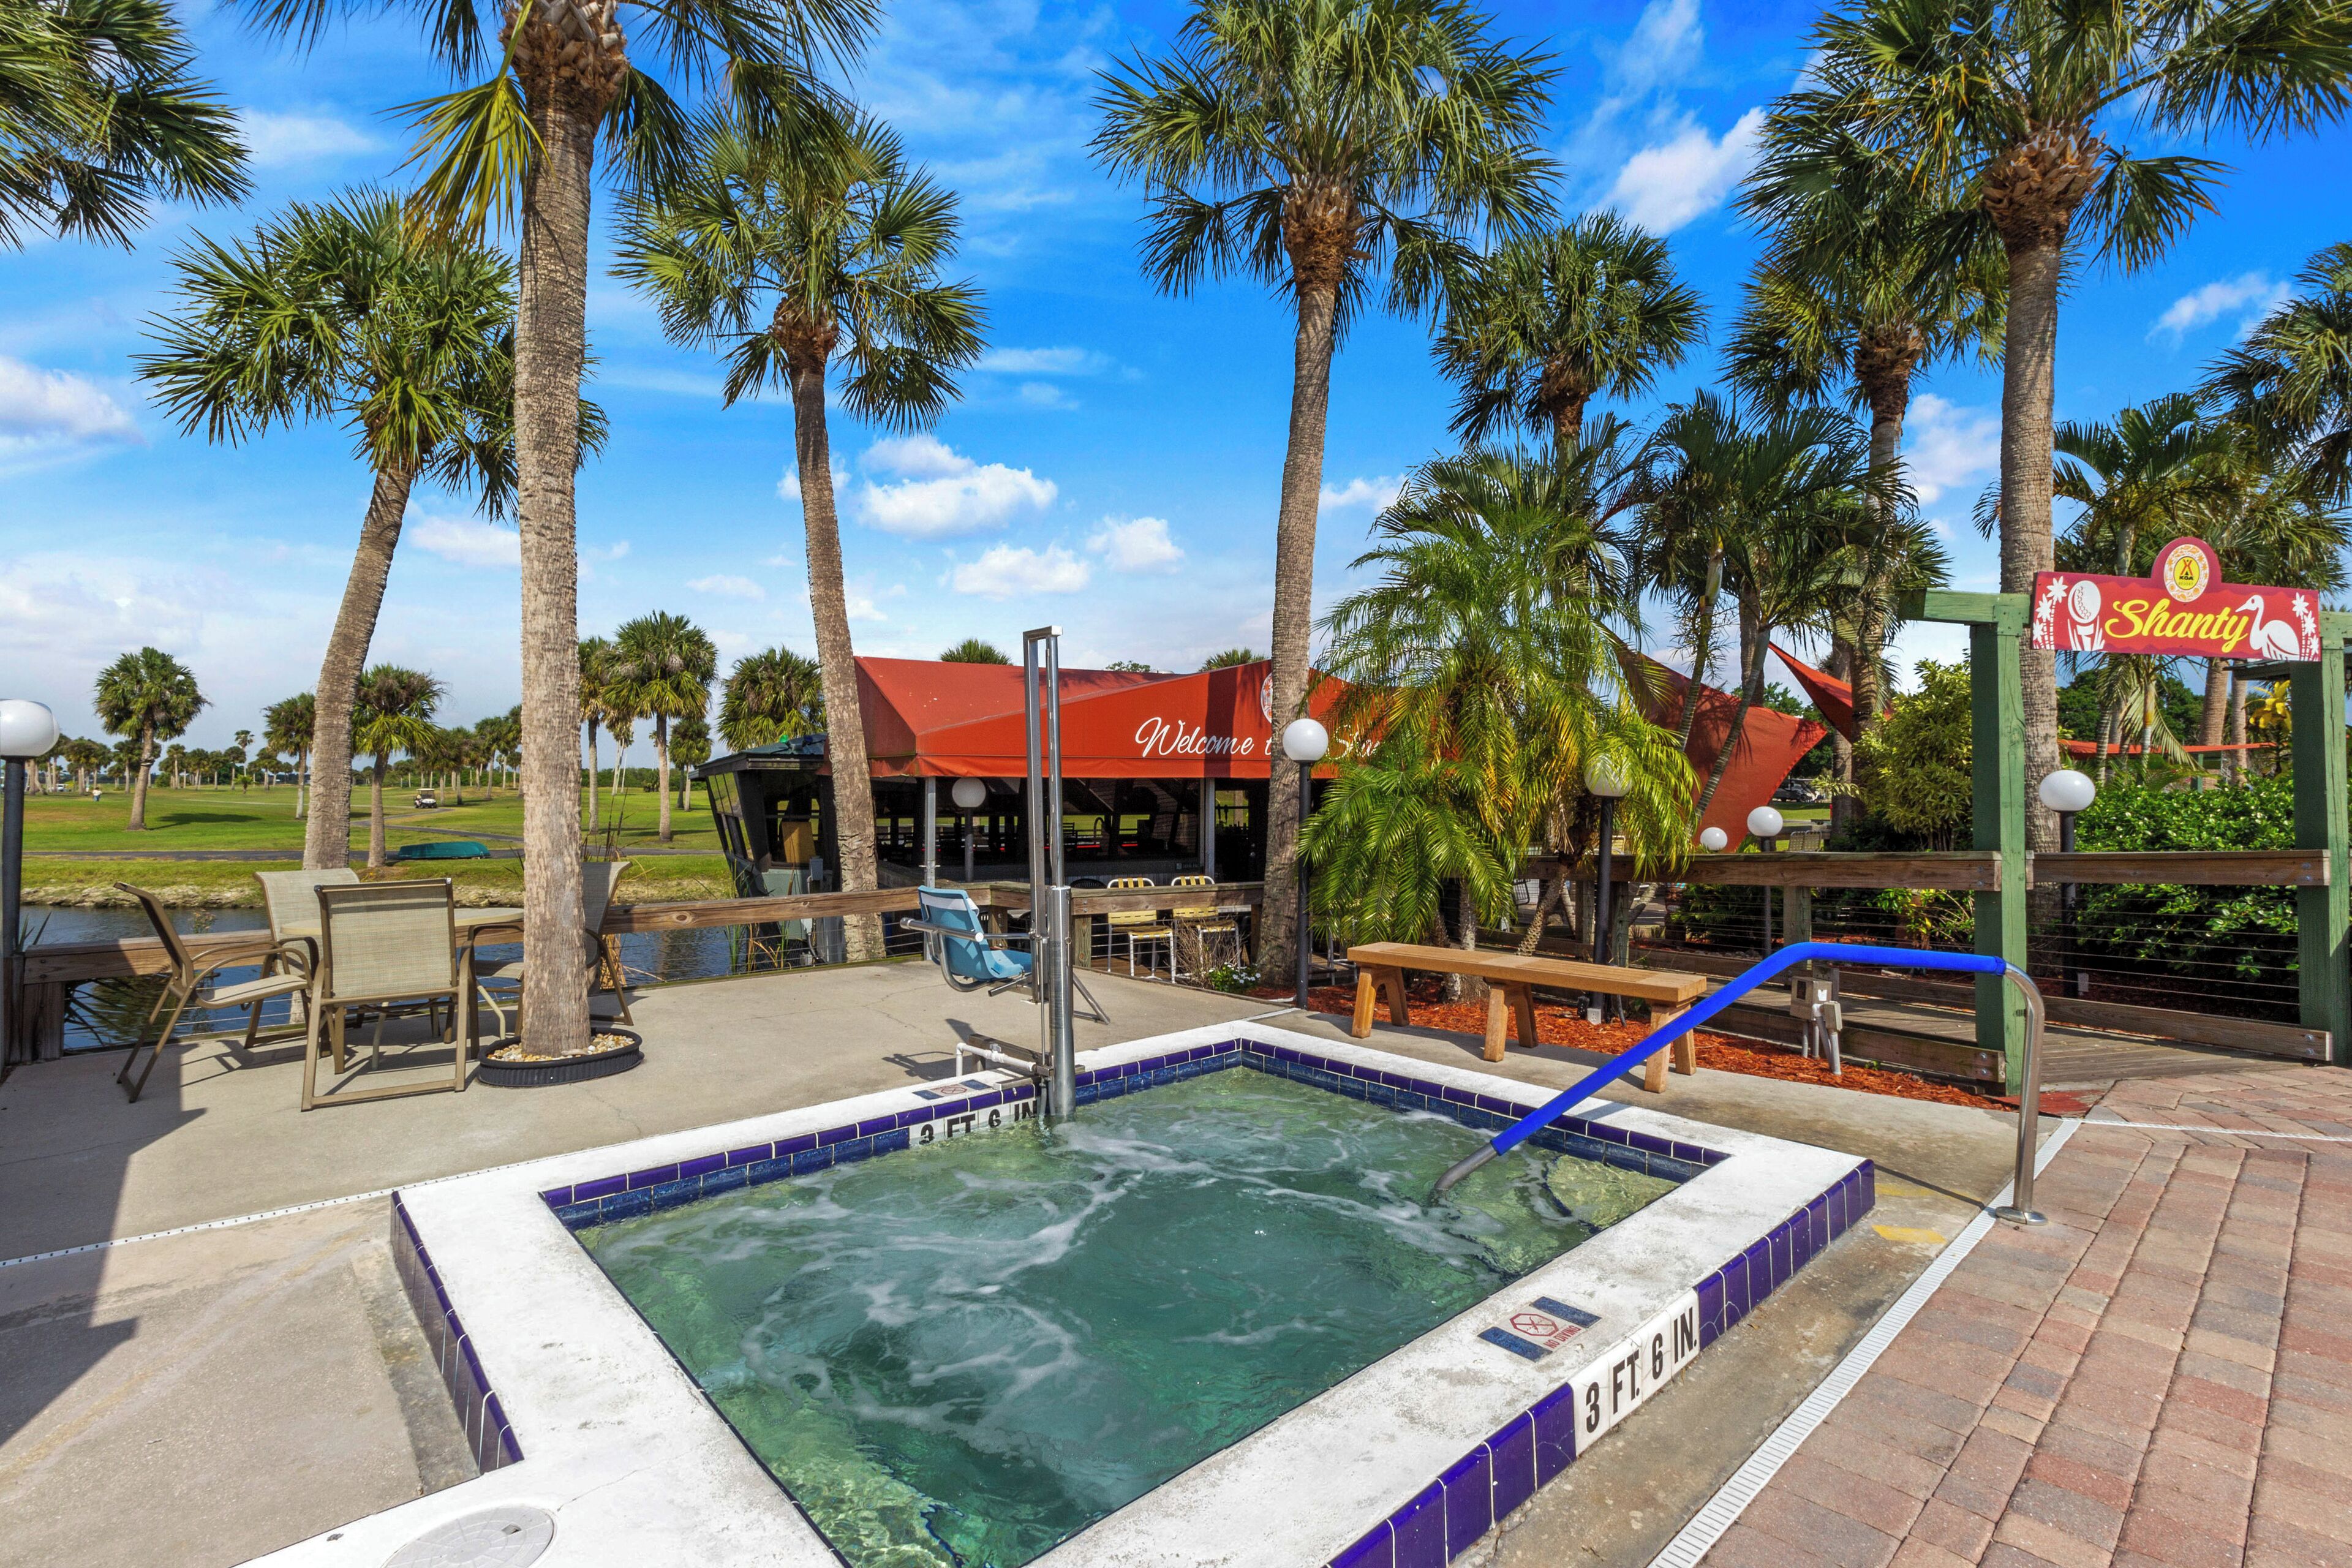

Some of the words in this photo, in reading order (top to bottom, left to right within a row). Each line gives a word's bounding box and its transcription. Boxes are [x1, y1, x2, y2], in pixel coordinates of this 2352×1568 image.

[2105, 598, 2249, 653] Shanty
[1135, 717, 1254, 757] Welcome
[919, 1124, 935, 1144] 3
[1544, 1339, 1560, 1349] NO
[1554, 1325, 1581, 1341] DIVING
[1586, 1382, 1600, 1433] 3
[1613, 1349, 1640, 1415] FT.
[1652, 1332, 1663, 1380] 6
[1673, 1306, 1697, 1364] IN.
